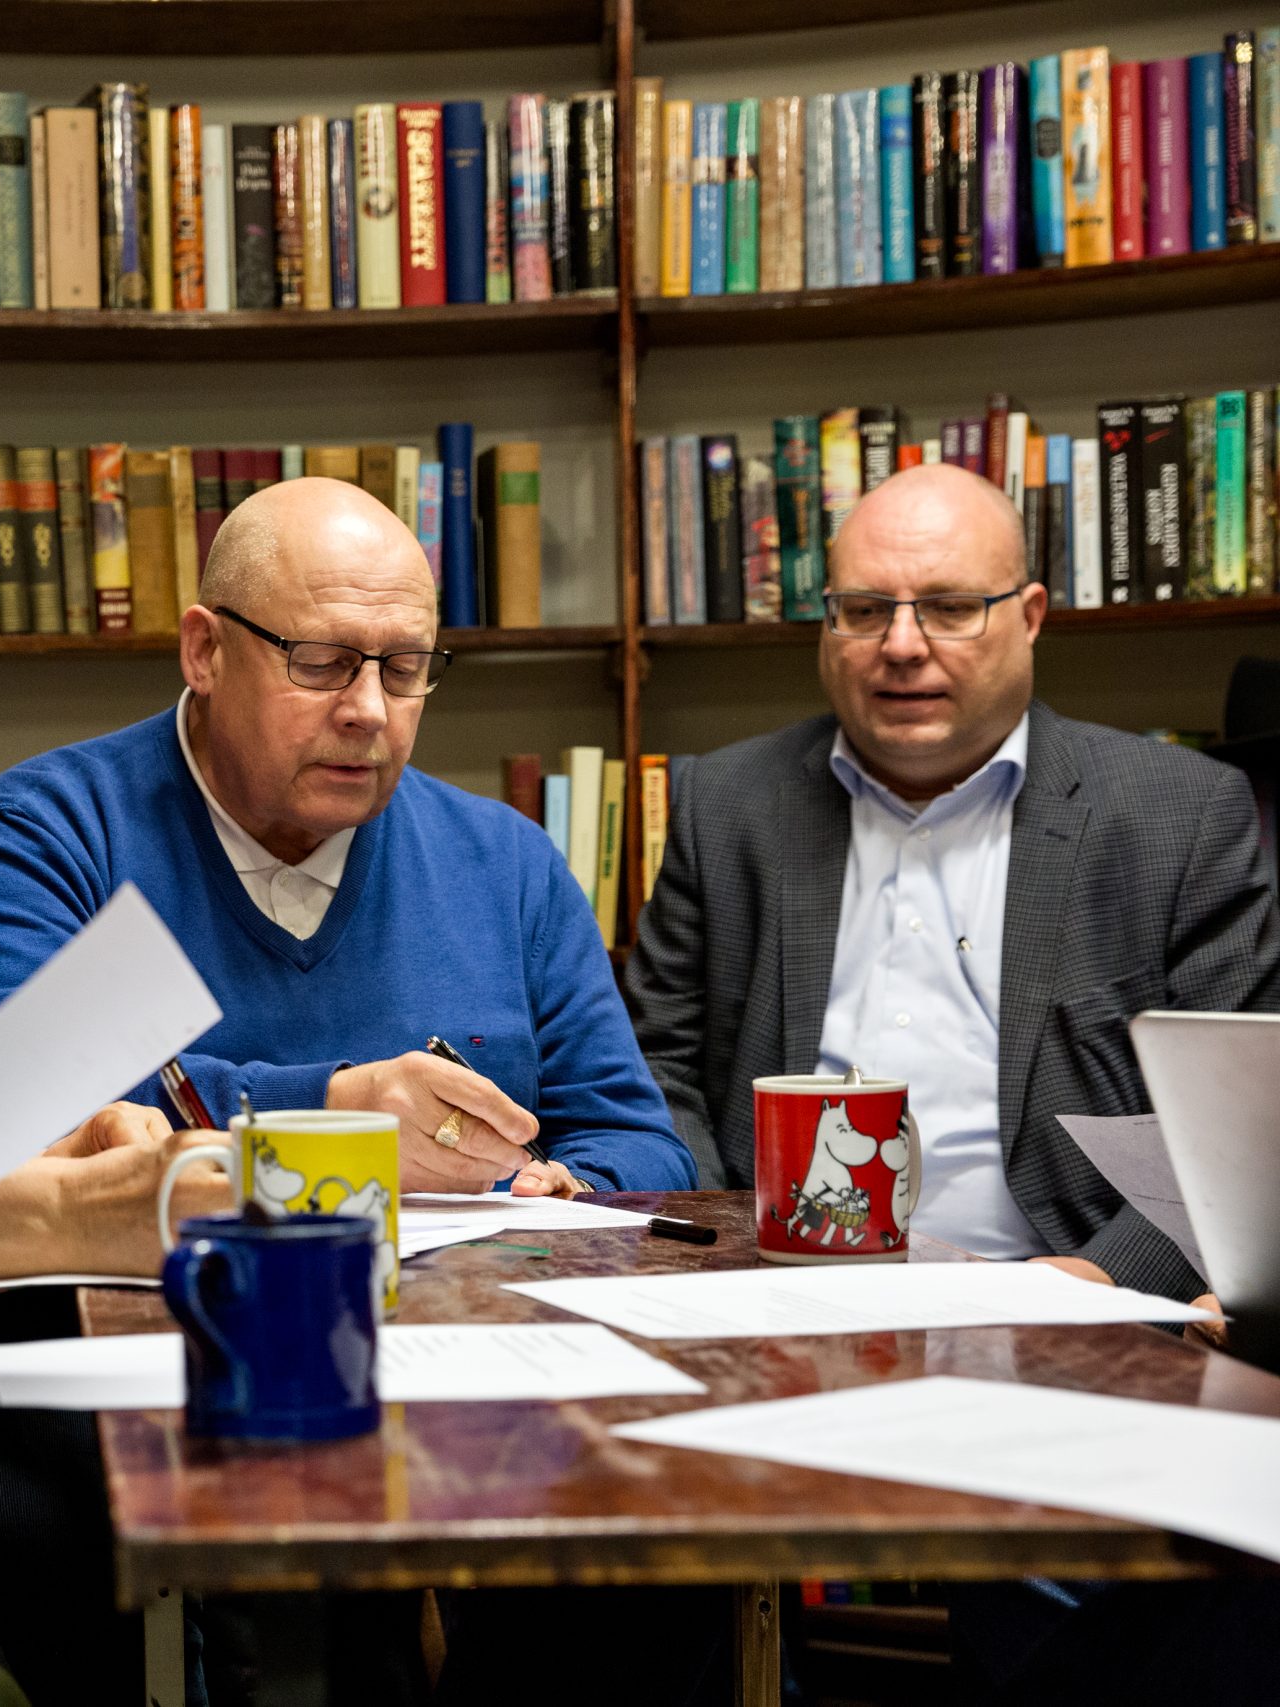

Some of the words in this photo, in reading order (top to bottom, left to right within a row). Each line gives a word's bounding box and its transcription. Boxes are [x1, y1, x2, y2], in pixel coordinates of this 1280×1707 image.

[407, 129, 437, 270] SCARLETT
[1109, 452, 1130, 581] VALTAISTUINPELI
[1160, 463, 1180, 568] KUNINKAIDEN
